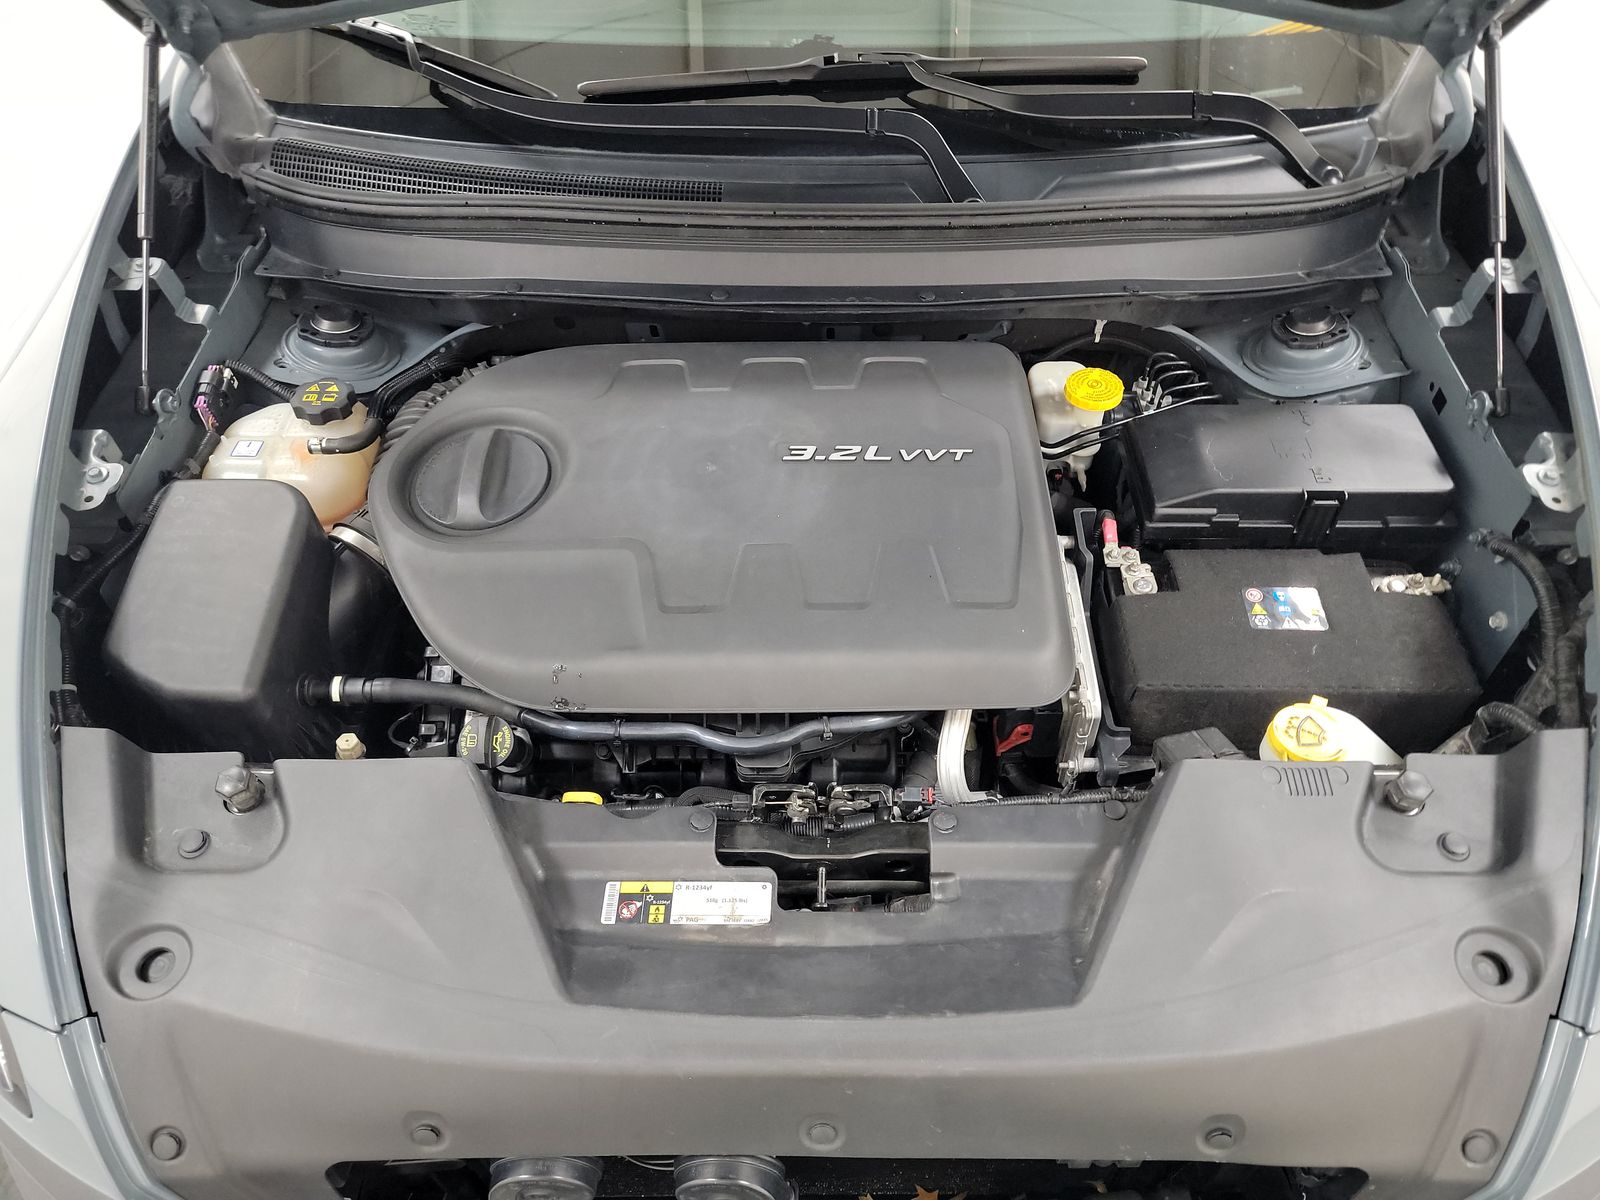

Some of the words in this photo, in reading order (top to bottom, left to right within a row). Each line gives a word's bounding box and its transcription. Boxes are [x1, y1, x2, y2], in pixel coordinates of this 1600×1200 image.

[782, 445, 892, 461] 3.2L
[899, 449, 974, 461] VVT
[462, 725, 472, 737] SAE
[502, 725, 511, 749] ENGINE
[498, 749, 509, 758] OIL
[685, 884, 713, 892] R-1234yf
